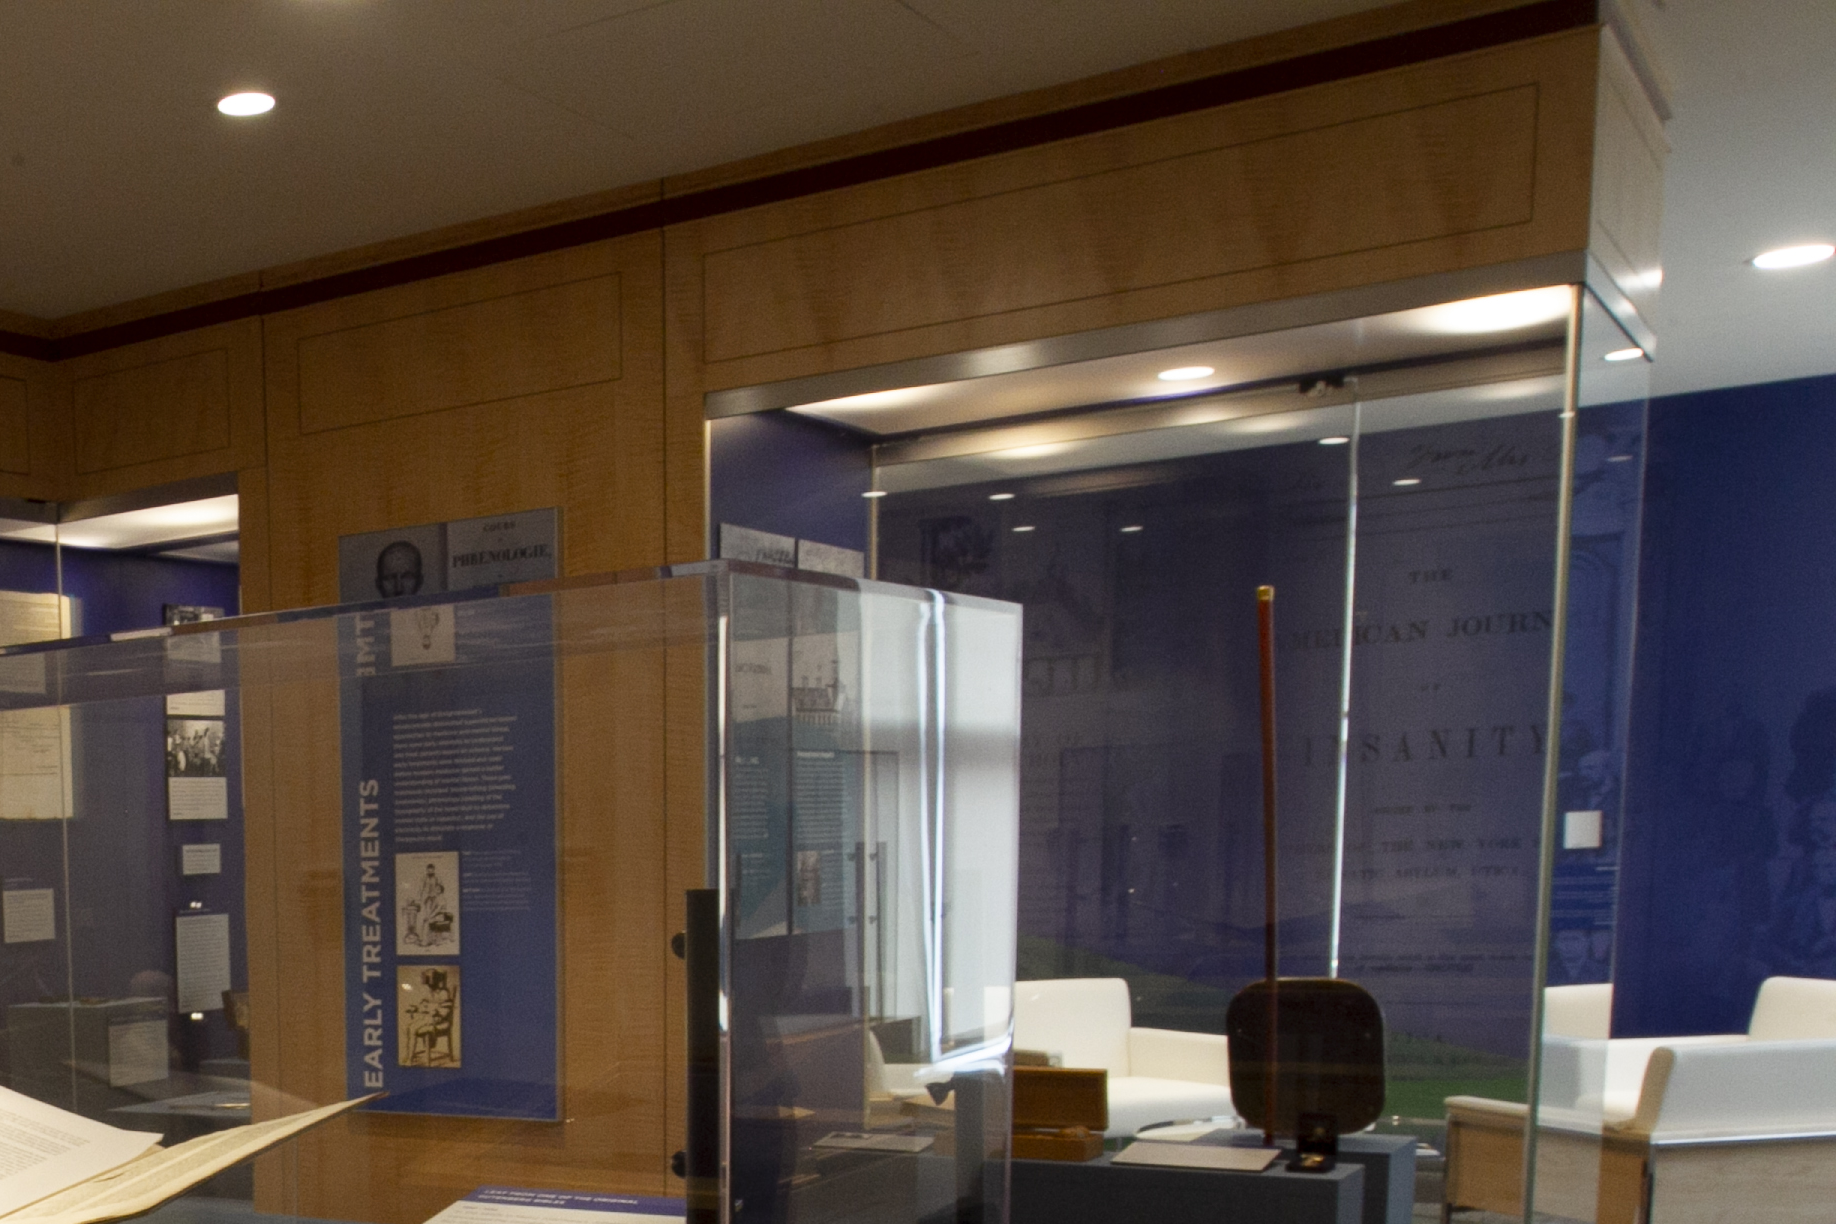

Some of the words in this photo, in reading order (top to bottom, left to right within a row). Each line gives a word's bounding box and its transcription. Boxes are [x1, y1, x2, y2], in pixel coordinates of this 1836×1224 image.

[1291, 619, 1429, 650] MERICAN
[1446, 610, 1553, 638] JOURN
[359, 778, 382, 983] TREATMENTS
[364, 993, 384, 1088] EARLY
